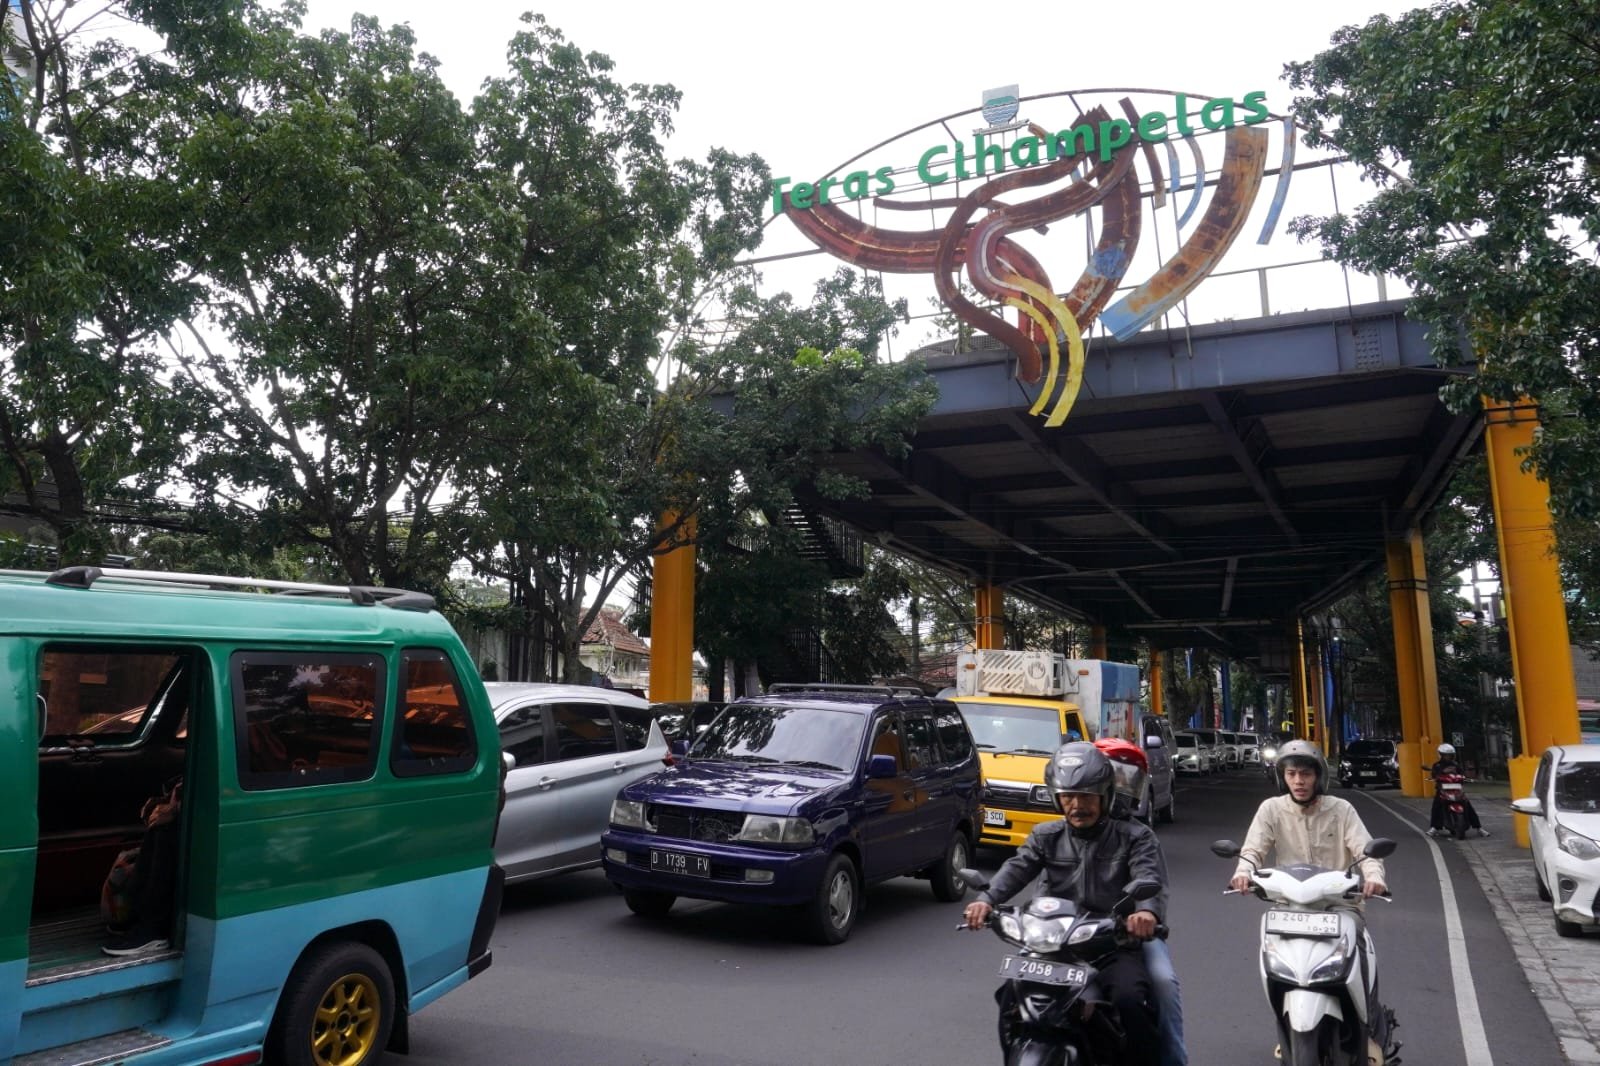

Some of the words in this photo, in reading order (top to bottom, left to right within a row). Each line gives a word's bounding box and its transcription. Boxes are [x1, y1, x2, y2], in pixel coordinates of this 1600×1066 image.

[772, 166, 896, 215] Teras
[917, 90, 1269, 185] Cihampelas
[652, 851, 658, 864] D
[665, 853, 686, 868] 1739
[697, 857, 708, 871] FV
[1004, 958, 1012, 969] T
[1020, 960, 1053, 976] 2058
[1067, 968, 1084, 982] ER
